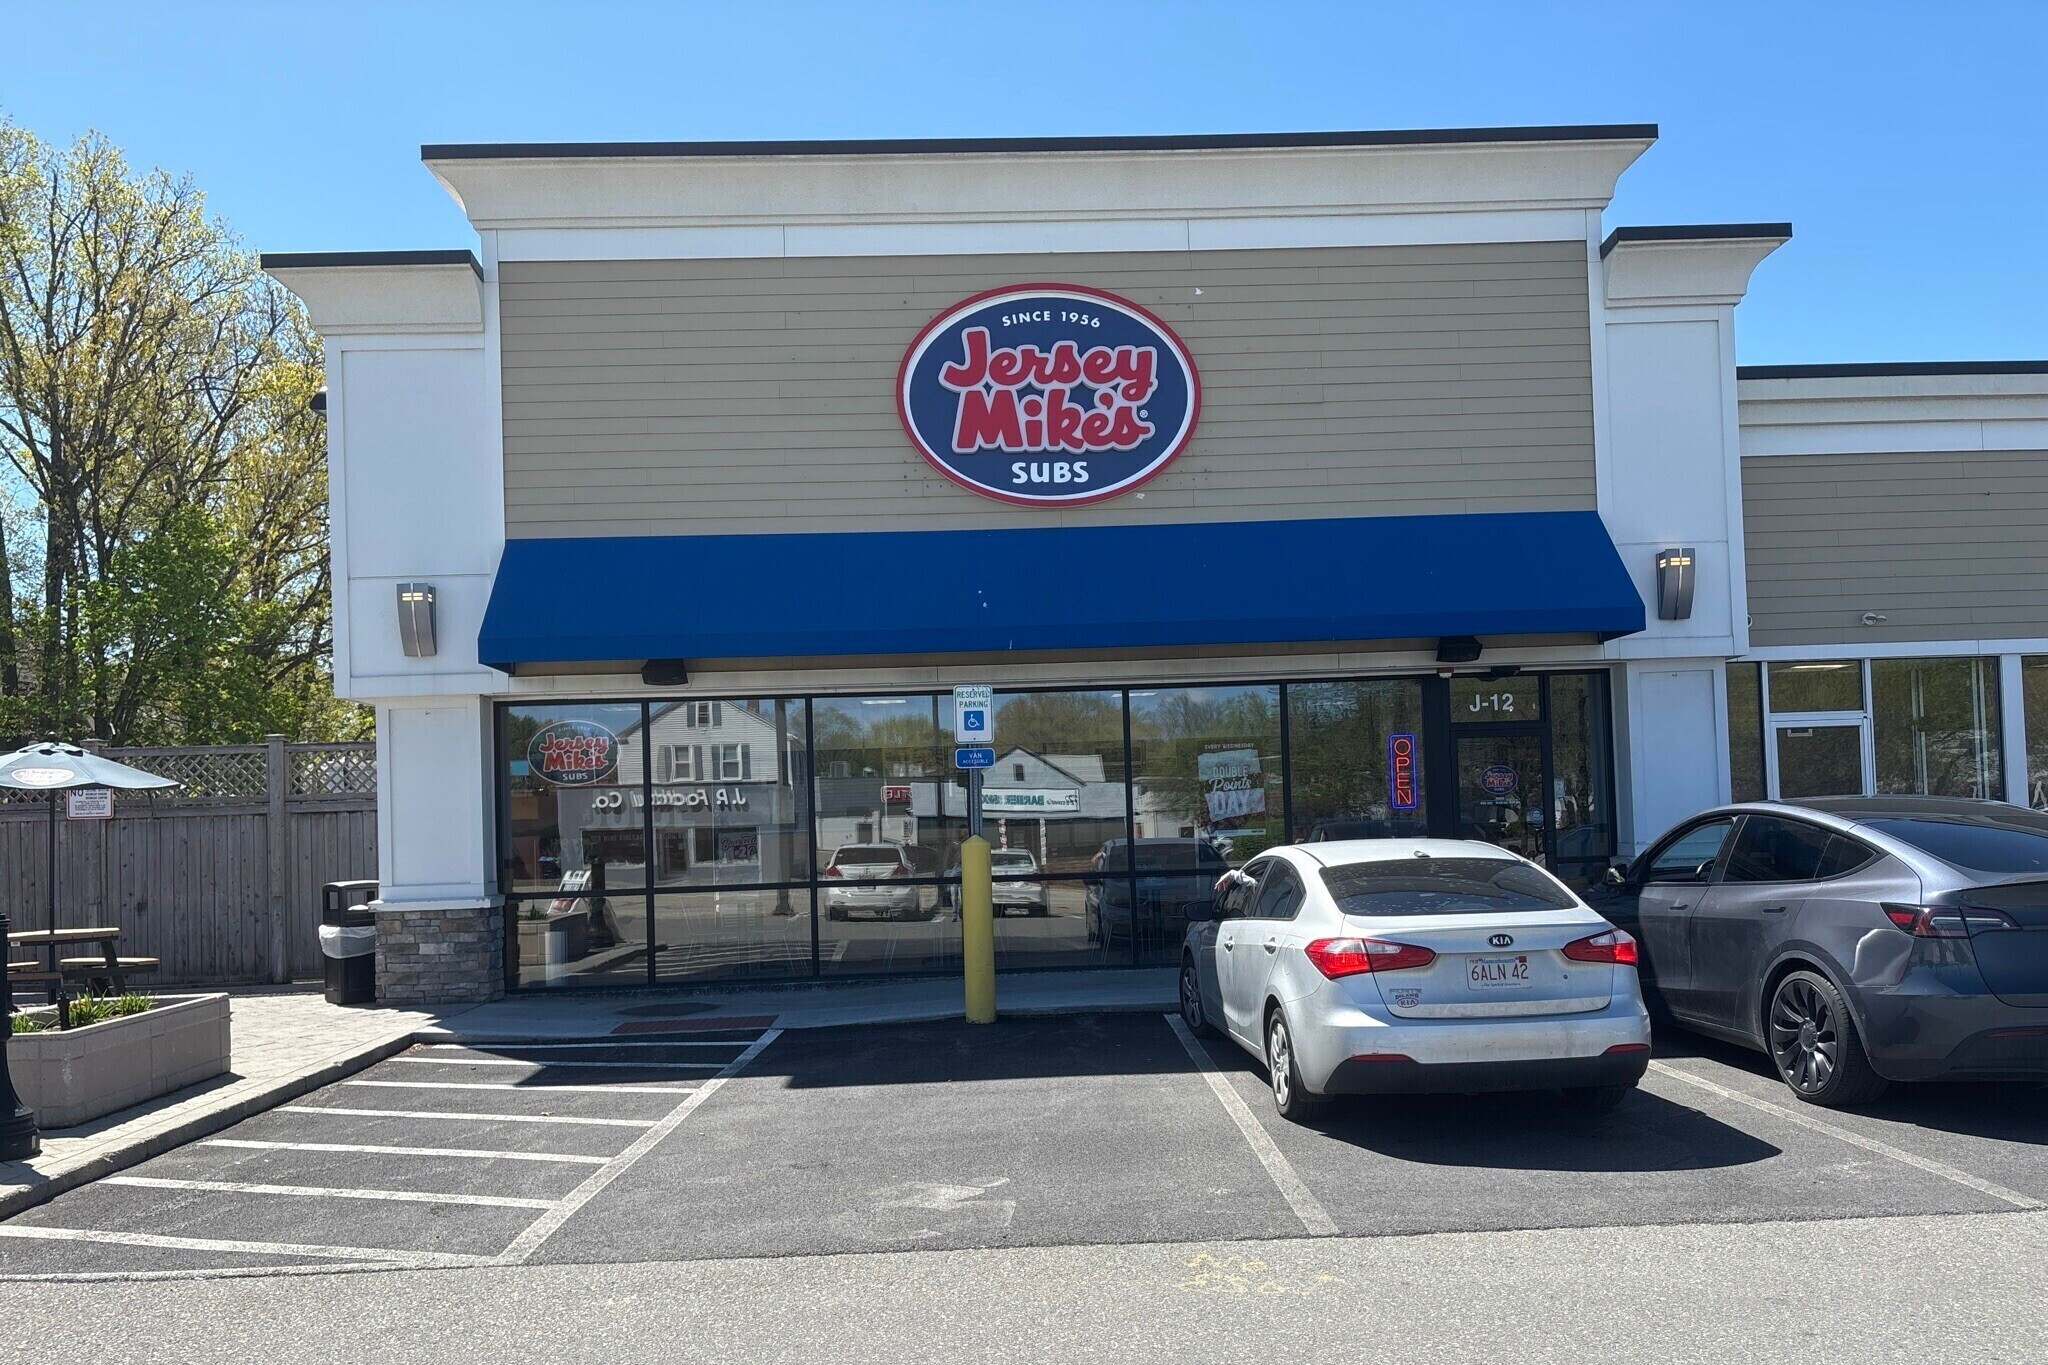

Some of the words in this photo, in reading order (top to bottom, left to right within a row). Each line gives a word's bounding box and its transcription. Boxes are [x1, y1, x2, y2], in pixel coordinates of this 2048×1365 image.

[1002, 311, 1051, 327] SINCE
[1060, 311, 1101, 328] 1956
[940, 327, 1157, 404] Jersey
[953, 387, 1155, 453] Mike's
[1011, 461, 1090, 484] SUBS
[959, 700, 989, 708] PARKING
[1469, 693, 1514, 712] J-12
[539, 733, 609, 755] Jersey
[562, 772, 588, 781] SUBS
[1212, 765, 1250, 778] DOUBLE
[1393, 738, 1412, 805] OPEN
[1208, 776, 1252, 793] Points
[1214, 790, 1251, 814] DAY
[1492, 936, 1511, 945] KIA
[1471, 964, 1507, 981] 6ALN
[1512, 963, 1529, 980] 42
